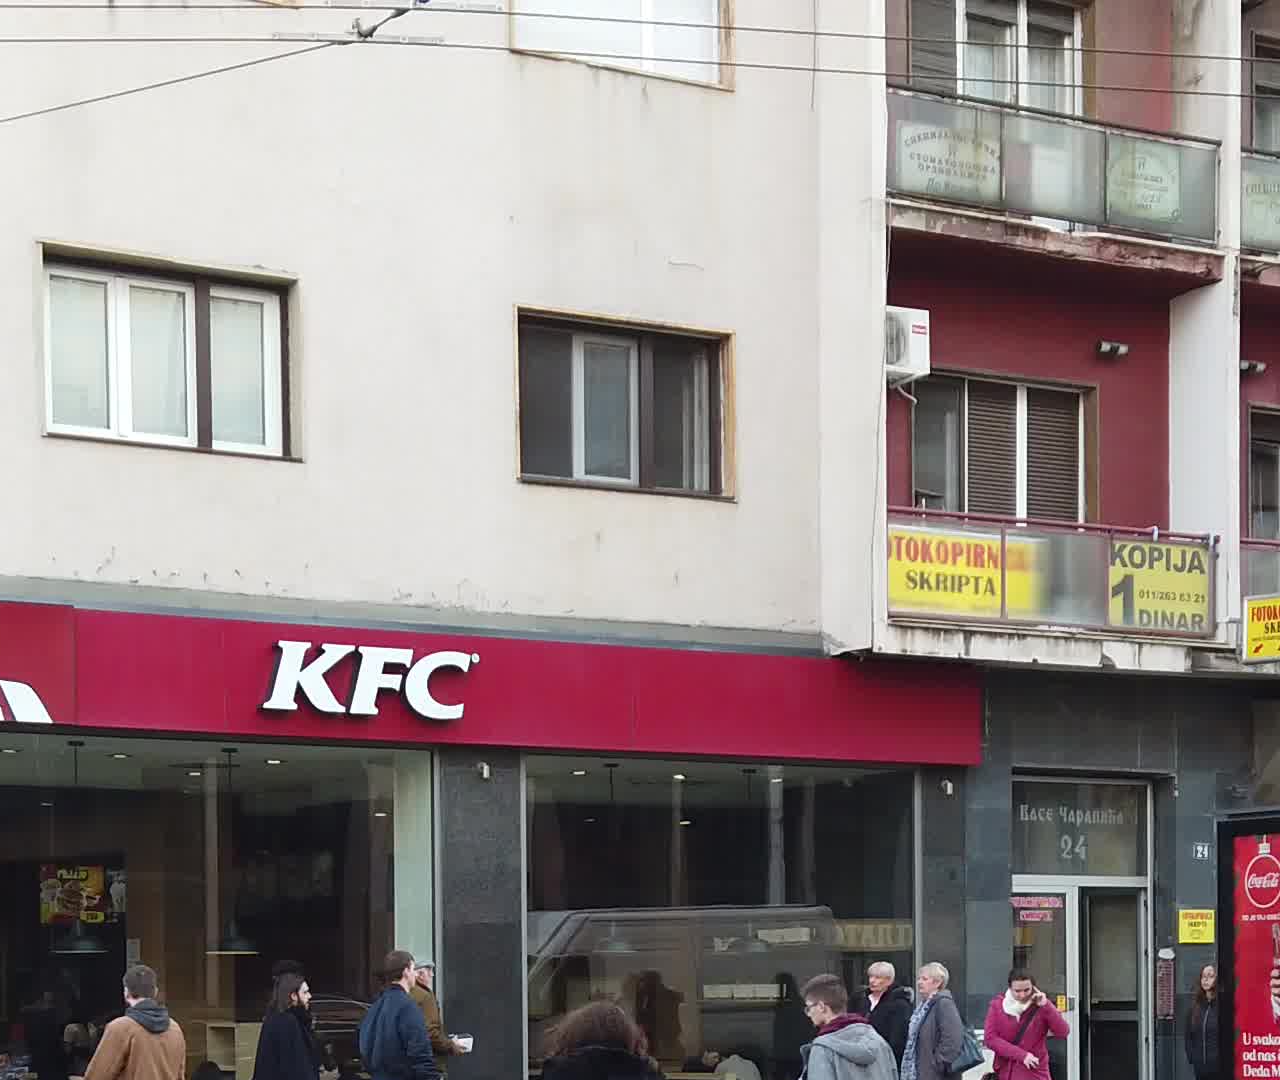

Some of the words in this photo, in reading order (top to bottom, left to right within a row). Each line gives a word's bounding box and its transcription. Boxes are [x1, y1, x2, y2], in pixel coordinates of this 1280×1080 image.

[1110, 544, 1206, 575] KOPIJA
[906, 570, 996, 597] SKRIPTA
[1112, 574, 1134, 625] 1
[1139, 609, 1205, 631] DINAR
[262, 639, 475, 720] KFC
[1060, 834, 1088, 860] 24
[1196, 844, 1209, 858] 24
[1247, 872, 1280, 889] Coca-Cola
[1242, 1032, 1252, 1046] U
[1242, 1049, 1257, 1061] od
[1258, 1052, 1276, 1062] nas
[1243, 1064, 1270, 1078] Deda
